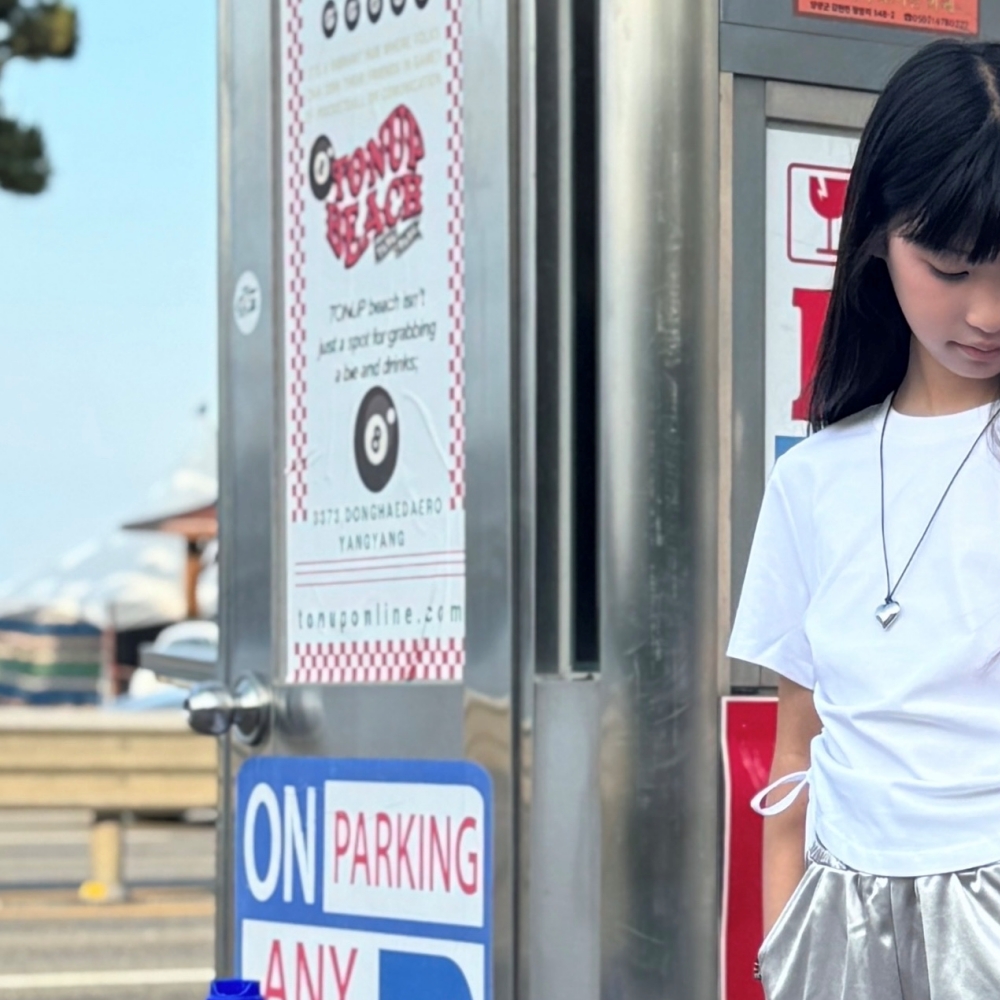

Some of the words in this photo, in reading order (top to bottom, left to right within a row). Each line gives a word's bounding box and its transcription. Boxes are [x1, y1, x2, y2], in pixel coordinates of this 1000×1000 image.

[332, 103, 426, 202] TONUP
[326, 174, 423, 270] BEACH
[329, 298, 367, 323] TONUP
[387, 320, 437, 349] grabbing
[338, 530, 405, 554] YANGYANG
[297, 602, 463, 631] tonuponline.com
[242, 781, 317, 905] ON
[333, 809, 479, 896] PARKING
